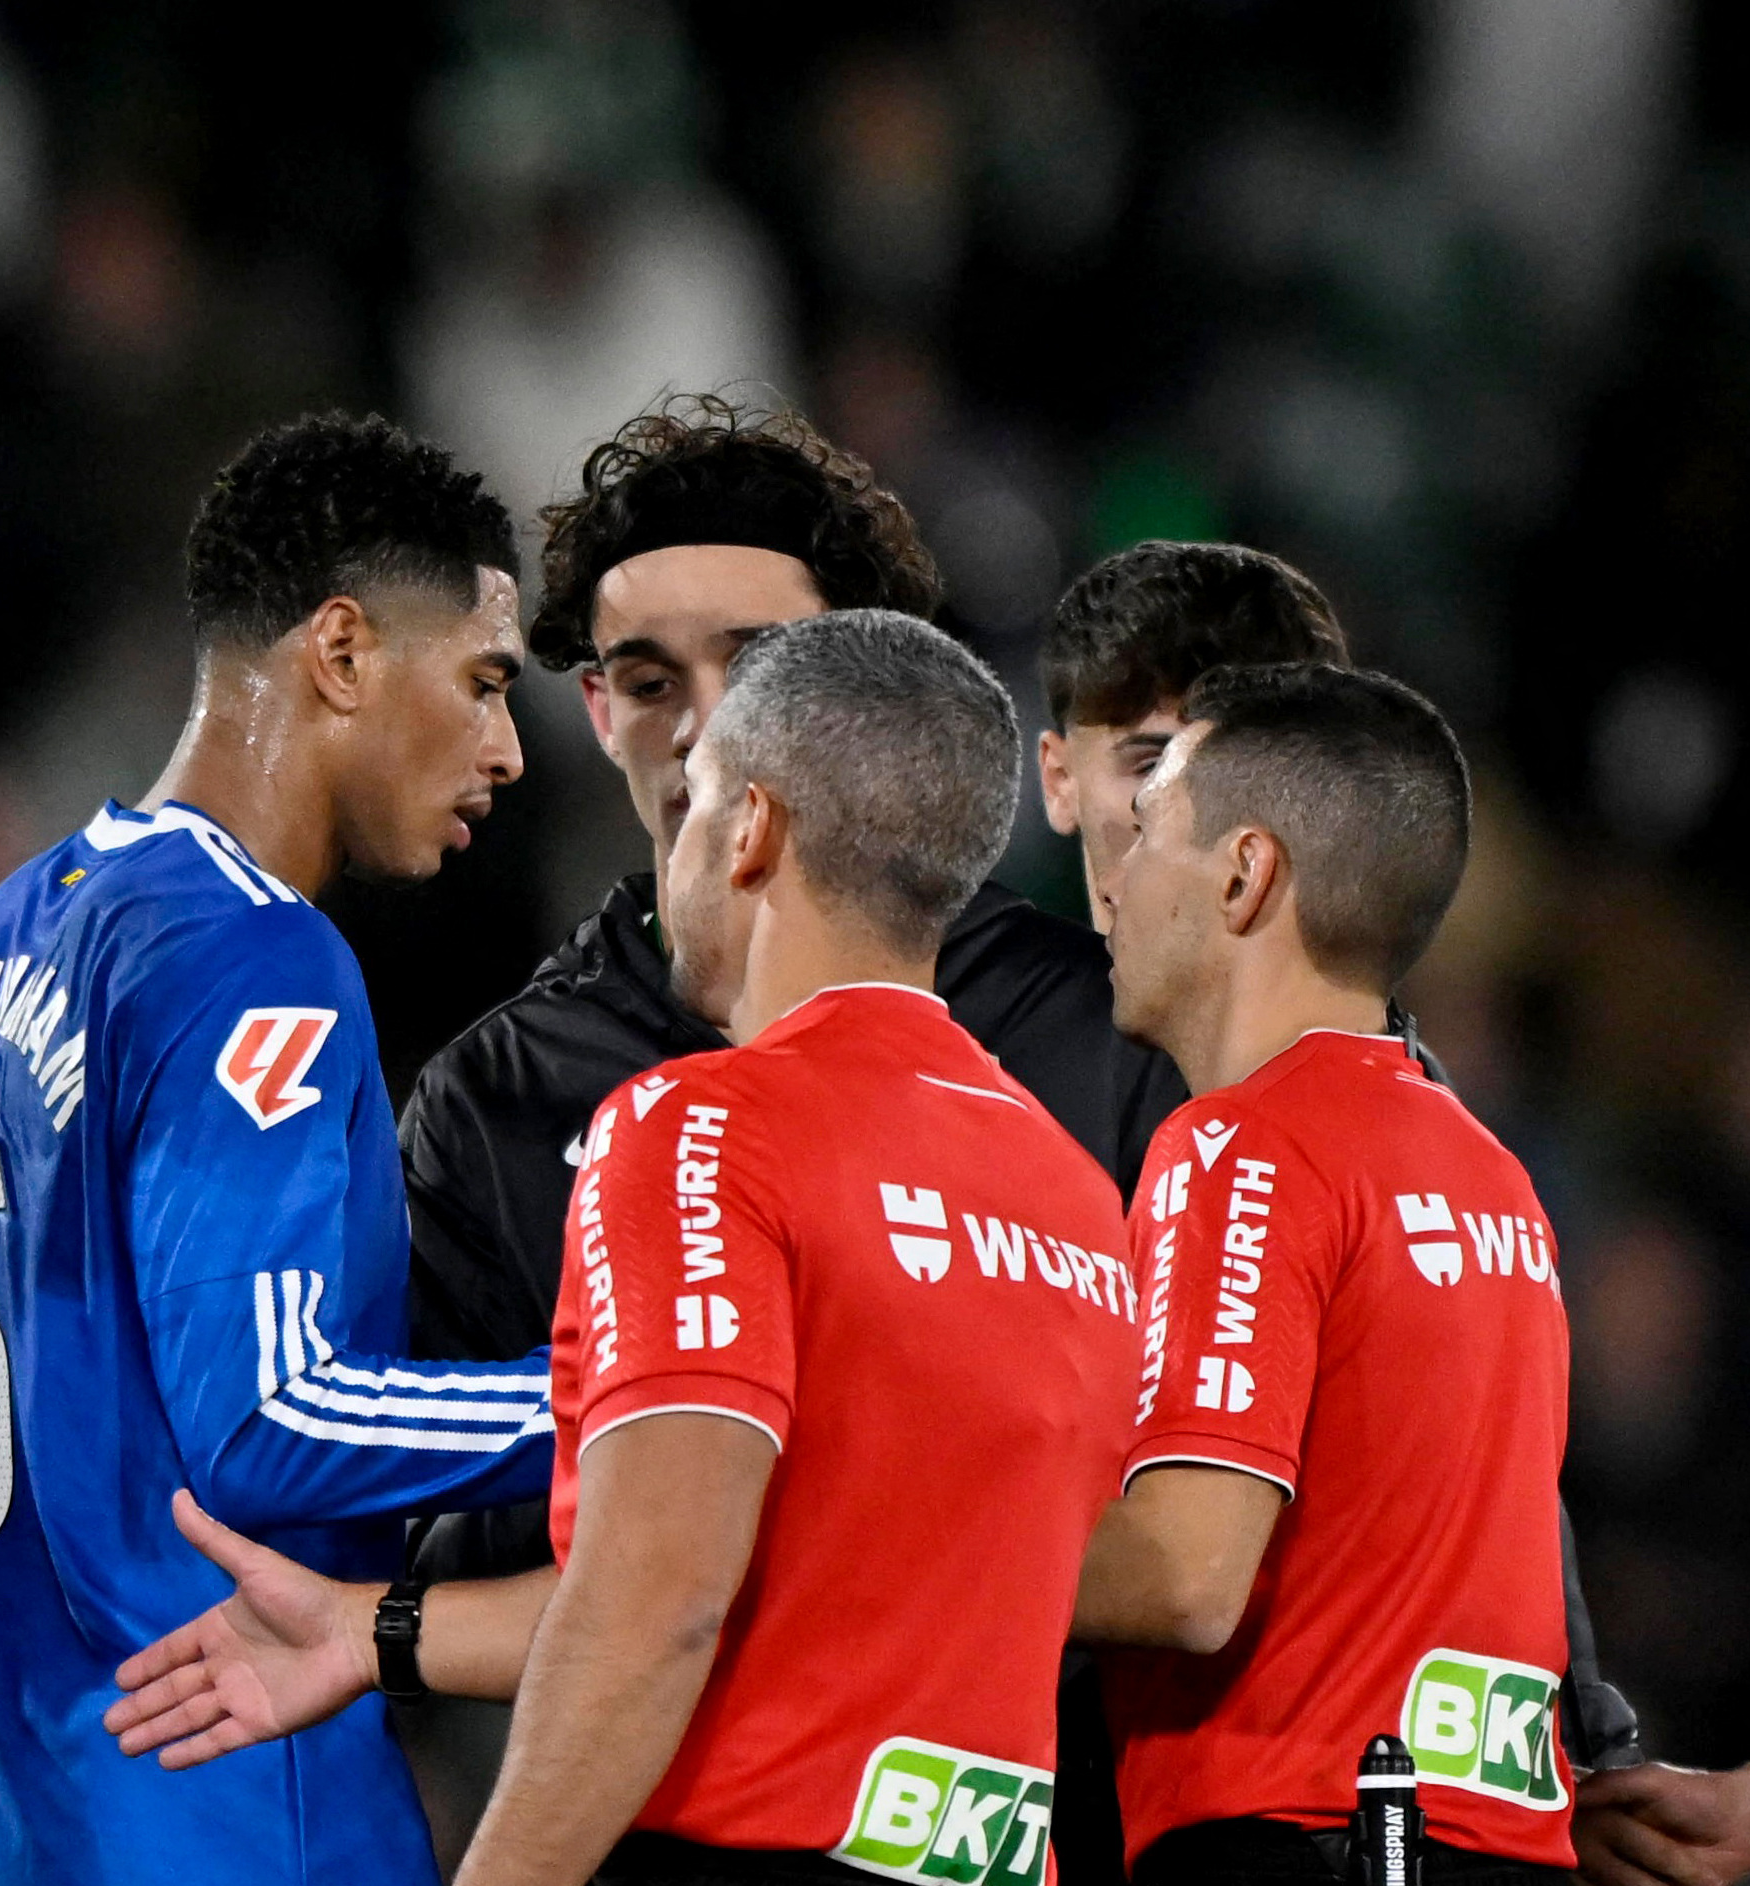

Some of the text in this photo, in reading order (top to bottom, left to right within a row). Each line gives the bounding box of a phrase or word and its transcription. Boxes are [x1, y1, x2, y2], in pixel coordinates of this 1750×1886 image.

[577, 1171, 619, 1376] WÜRTH
[675, 1104, 729, 1284] WÜRTH
[1214, 1157, 1277, 1345] WÜRTH
[1461, 1211, 1562, 1303] WÜ
[1134, 1225, 1177, 1427] WÜRTH
[862, 1769, 1050, 1876] BKT
